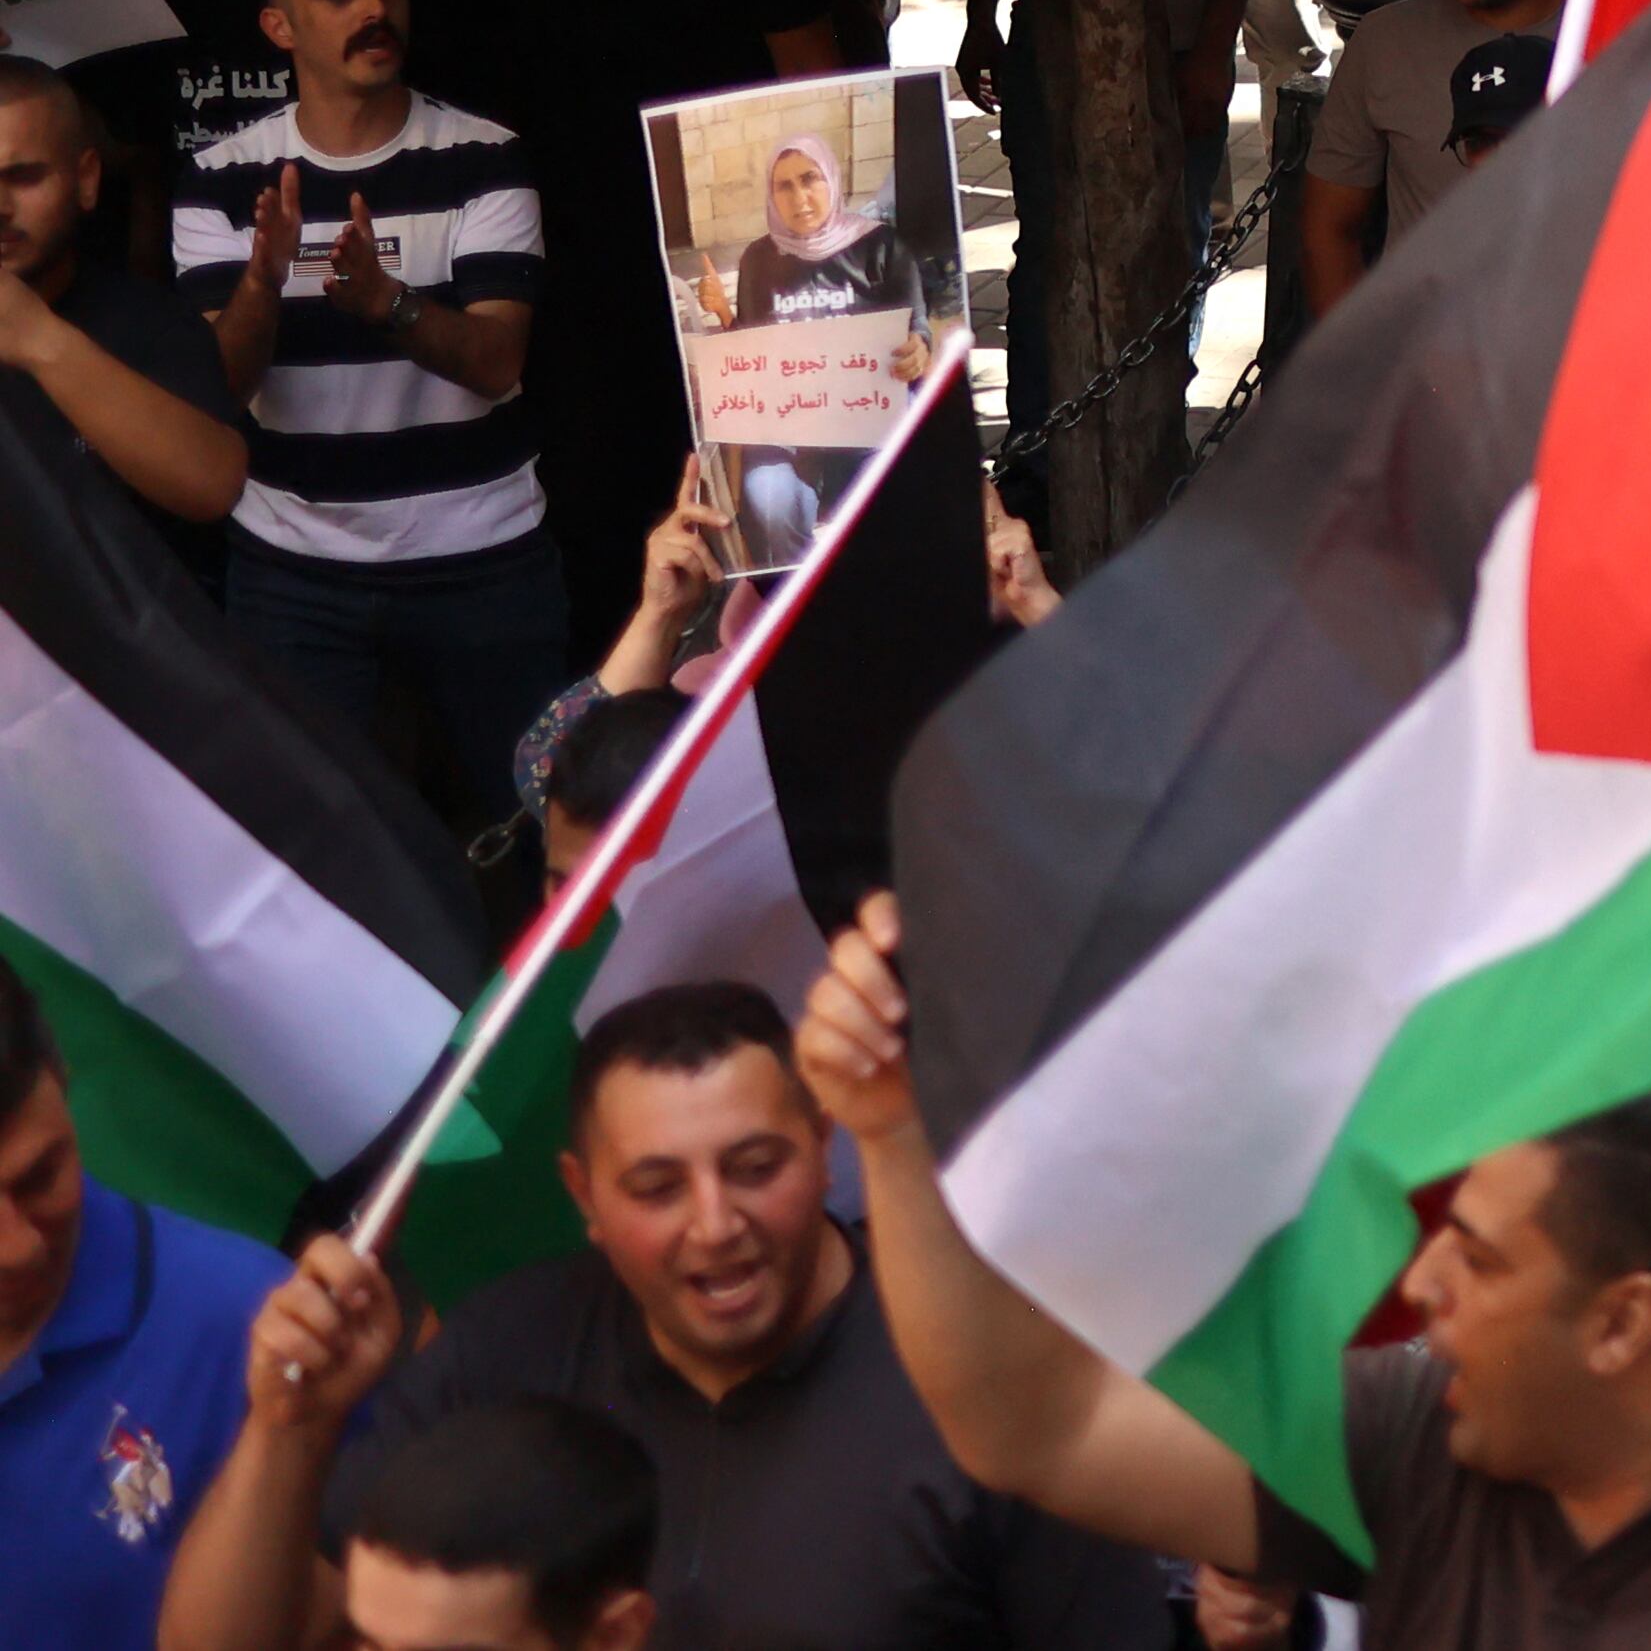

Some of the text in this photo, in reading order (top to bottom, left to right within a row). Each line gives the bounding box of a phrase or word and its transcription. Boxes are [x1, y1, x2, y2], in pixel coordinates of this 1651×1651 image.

[176, 64, 290, 110] كلنا غزة
[780, 354, 828, 377] تجويع
[840, 353, 879, 373] وقف
[842, 390, 891, 411] واجب
